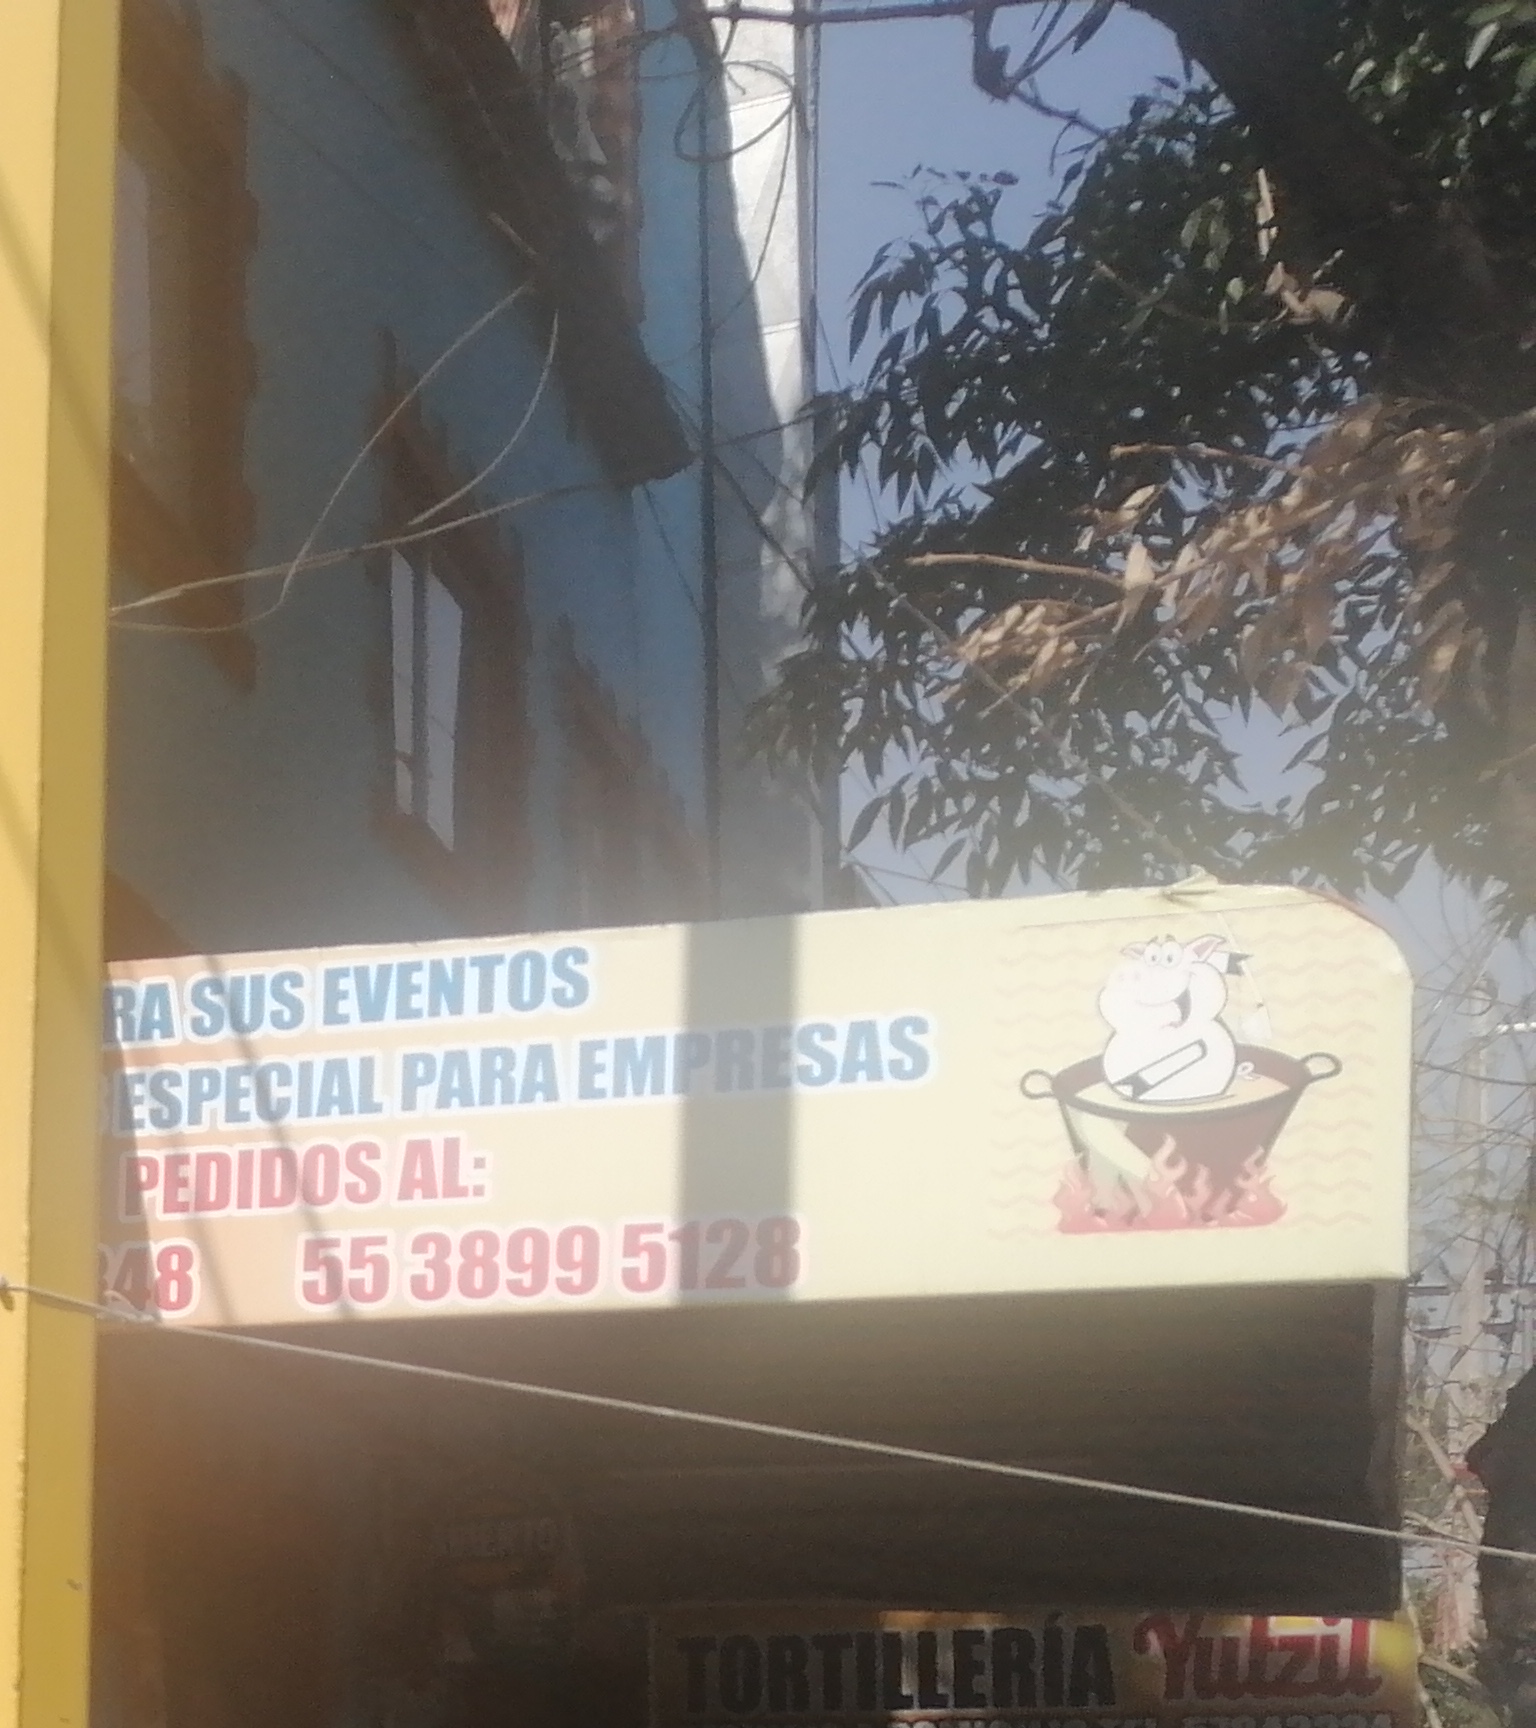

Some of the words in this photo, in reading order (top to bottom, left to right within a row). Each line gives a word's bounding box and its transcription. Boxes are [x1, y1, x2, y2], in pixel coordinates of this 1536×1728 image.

[101, 981, 176, 1043] RA
[189, 969, 306, 1038] SUS
[322, 945, 591, 1027] EVENTOS
[117, 1054, 384, 1132] ESPECIAL
[400, 1042, 560, 1113] PARA
[577, 1014, 931, 1101] EMPRESAS
[123, 1140, 383, 1217] PEDIDOS
[396, 1136, 488, 1202] AL:
[301, 1233, 391, 1306] 55
[409, 1225, 601, 1301] 3899
[620, 1215, 802, 1293] 5128
[677, 1609, 1116, 1711] TORTILLERÍA
